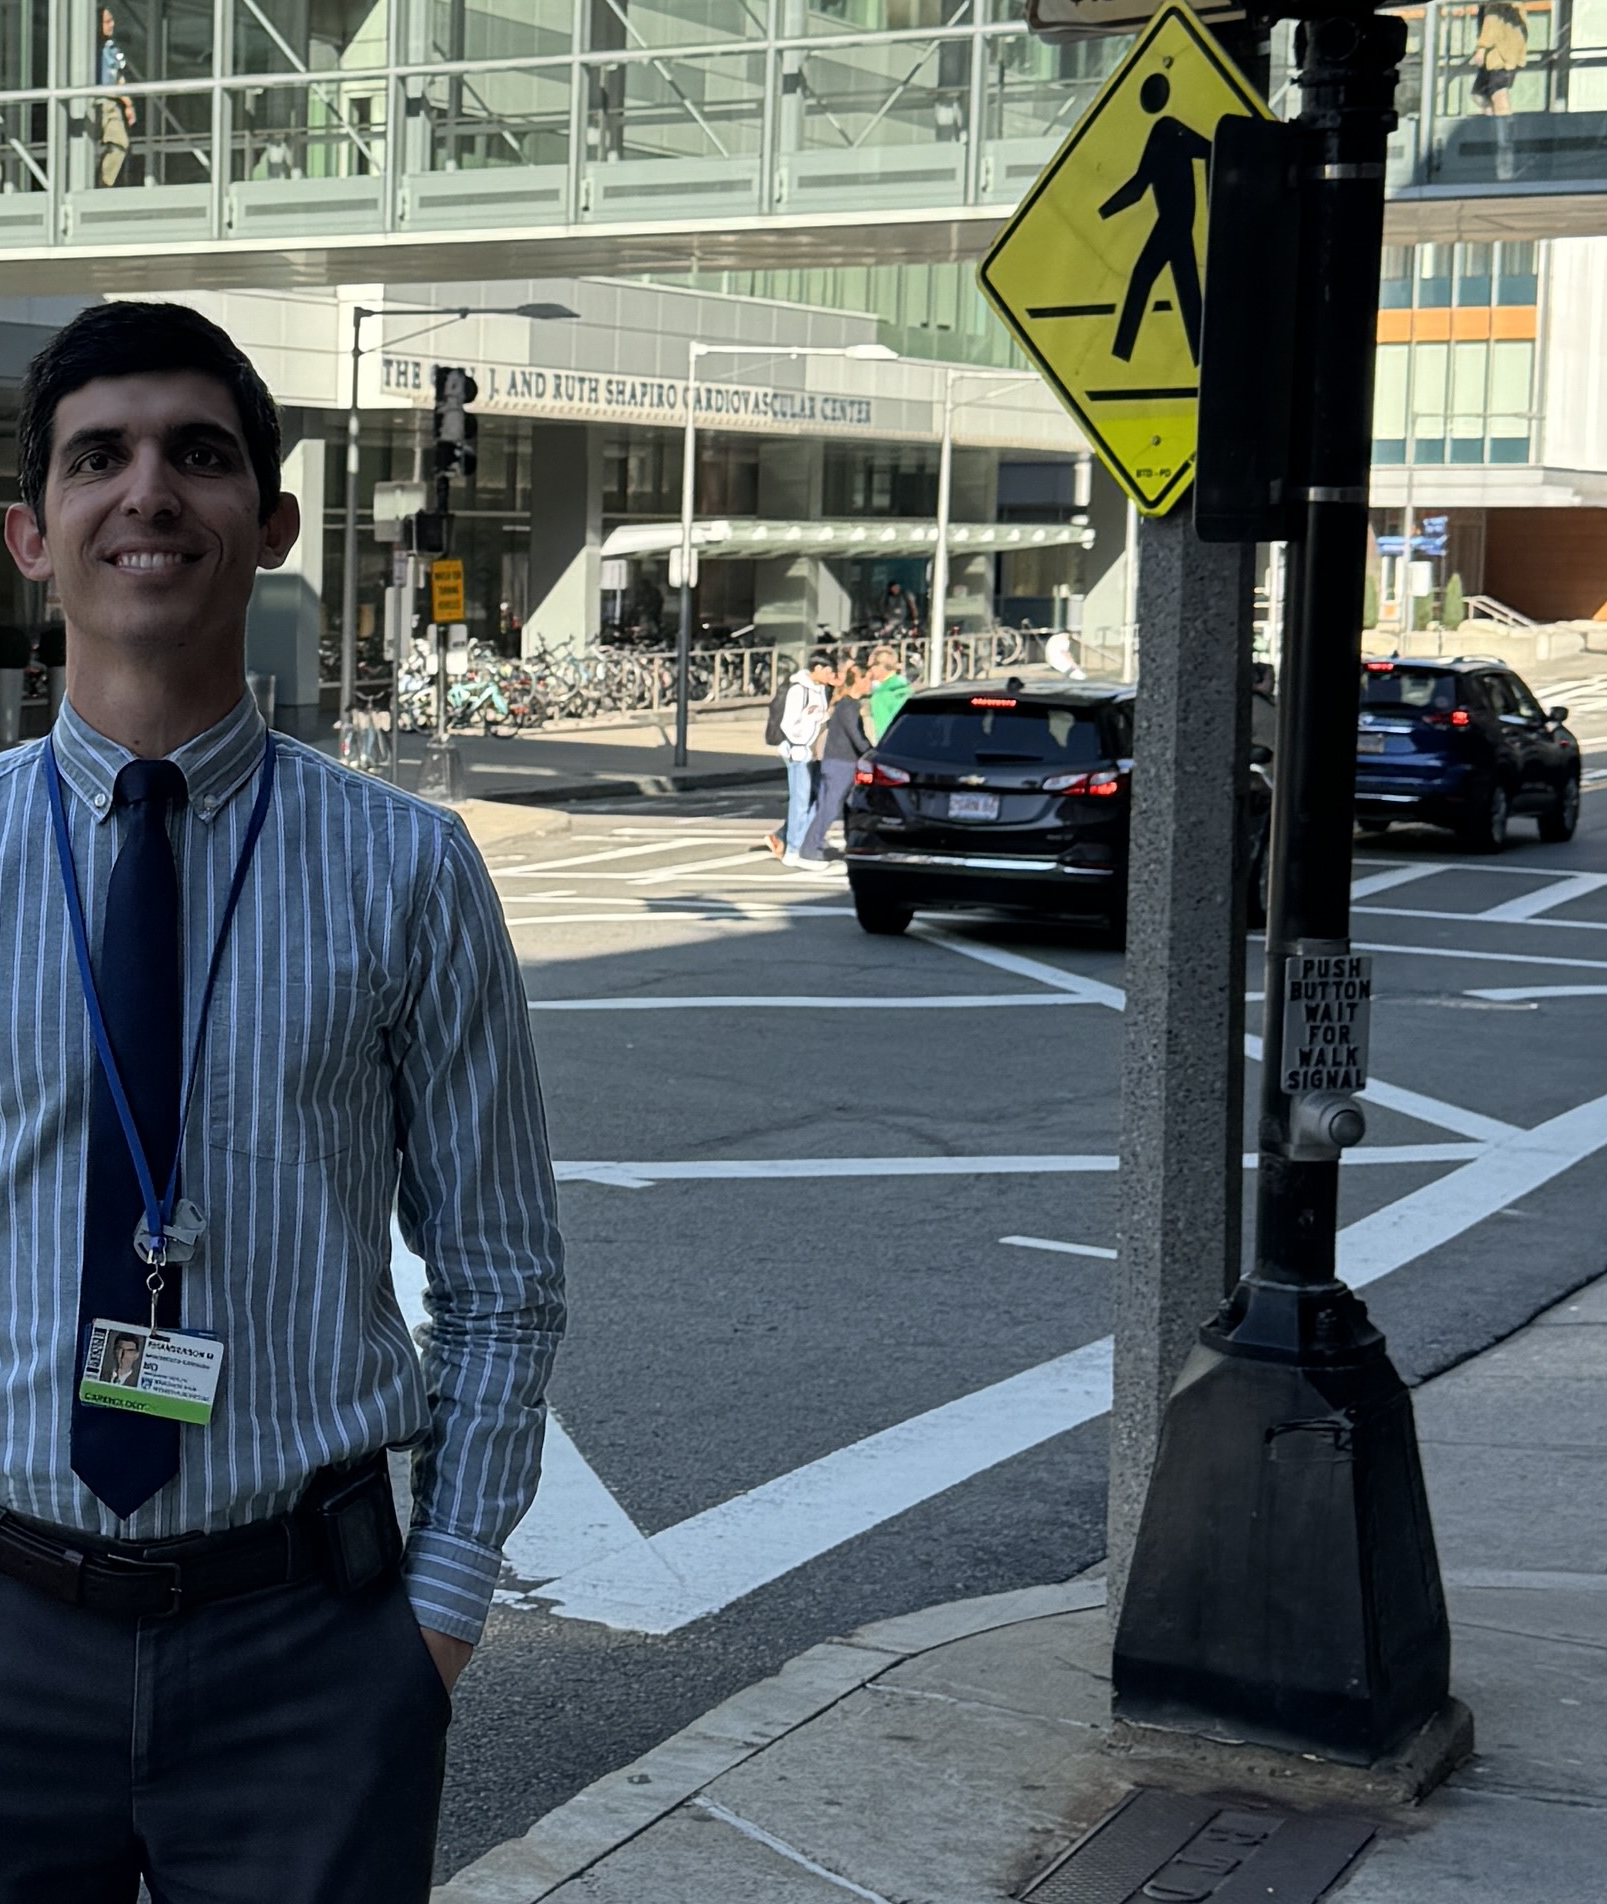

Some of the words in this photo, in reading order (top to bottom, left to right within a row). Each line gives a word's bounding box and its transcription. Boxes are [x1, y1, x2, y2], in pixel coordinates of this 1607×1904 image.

[382, 358, 421, 389] THE
[507, 369, 546, 399] AND
[552, 374, 599, 404] RUTH
[605, 379, 677, 410] SHAPIRO
[821, 398, 872, 424] CENTER
[1302, 957, 1361, 980] PUSH
[1290, 980, 1371, 1001] BUTTON
[1305, 1001, 1359, 1023] WAIT
[1309, 1024, 1350, 1045] FOR
[1299, 1046, 1359, 1068] WALK
[1287, 1068, 1367, 1090] SIGNAL
